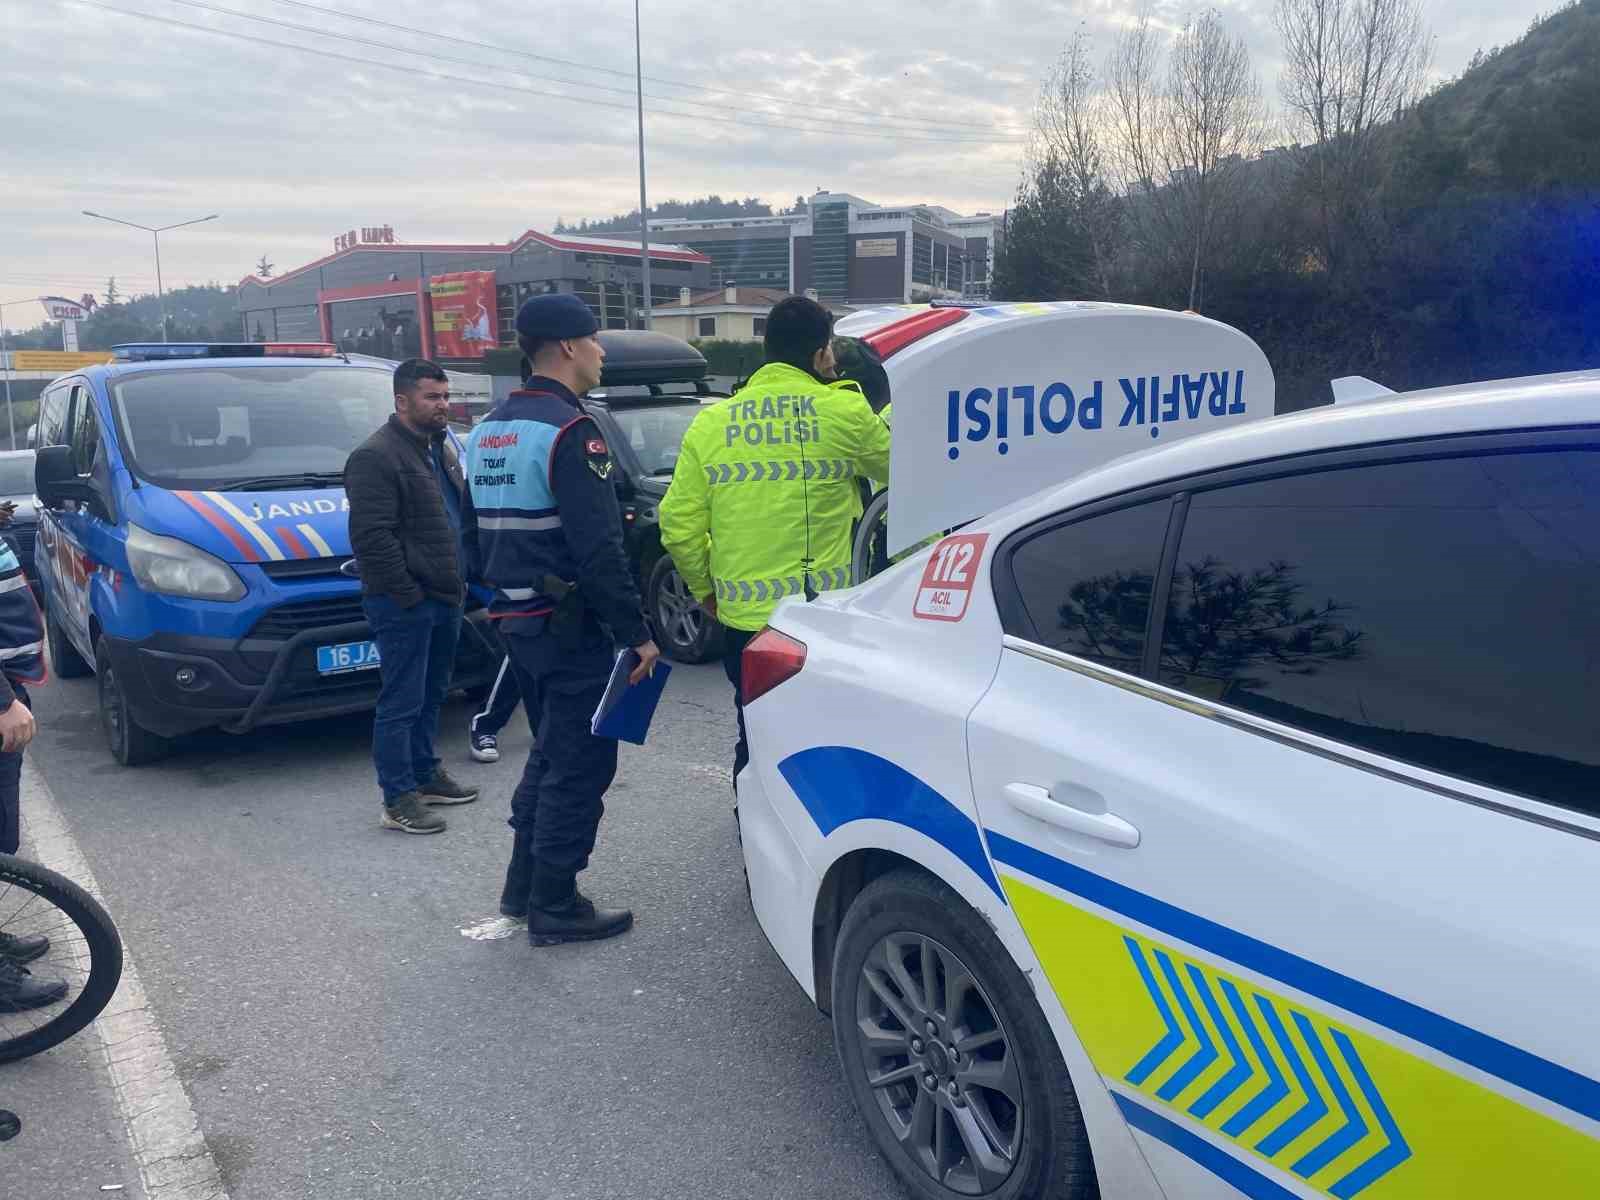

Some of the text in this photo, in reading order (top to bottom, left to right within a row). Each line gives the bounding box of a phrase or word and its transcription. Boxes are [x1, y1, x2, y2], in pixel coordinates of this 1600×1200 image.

[728, 395, 817, 421] TRAFİK
[947, 369, 1247, 461] TRAFİK POLİSİ
[725, 420, 820, 447] POLİSİ
[932, 543, 974, 582] 112
